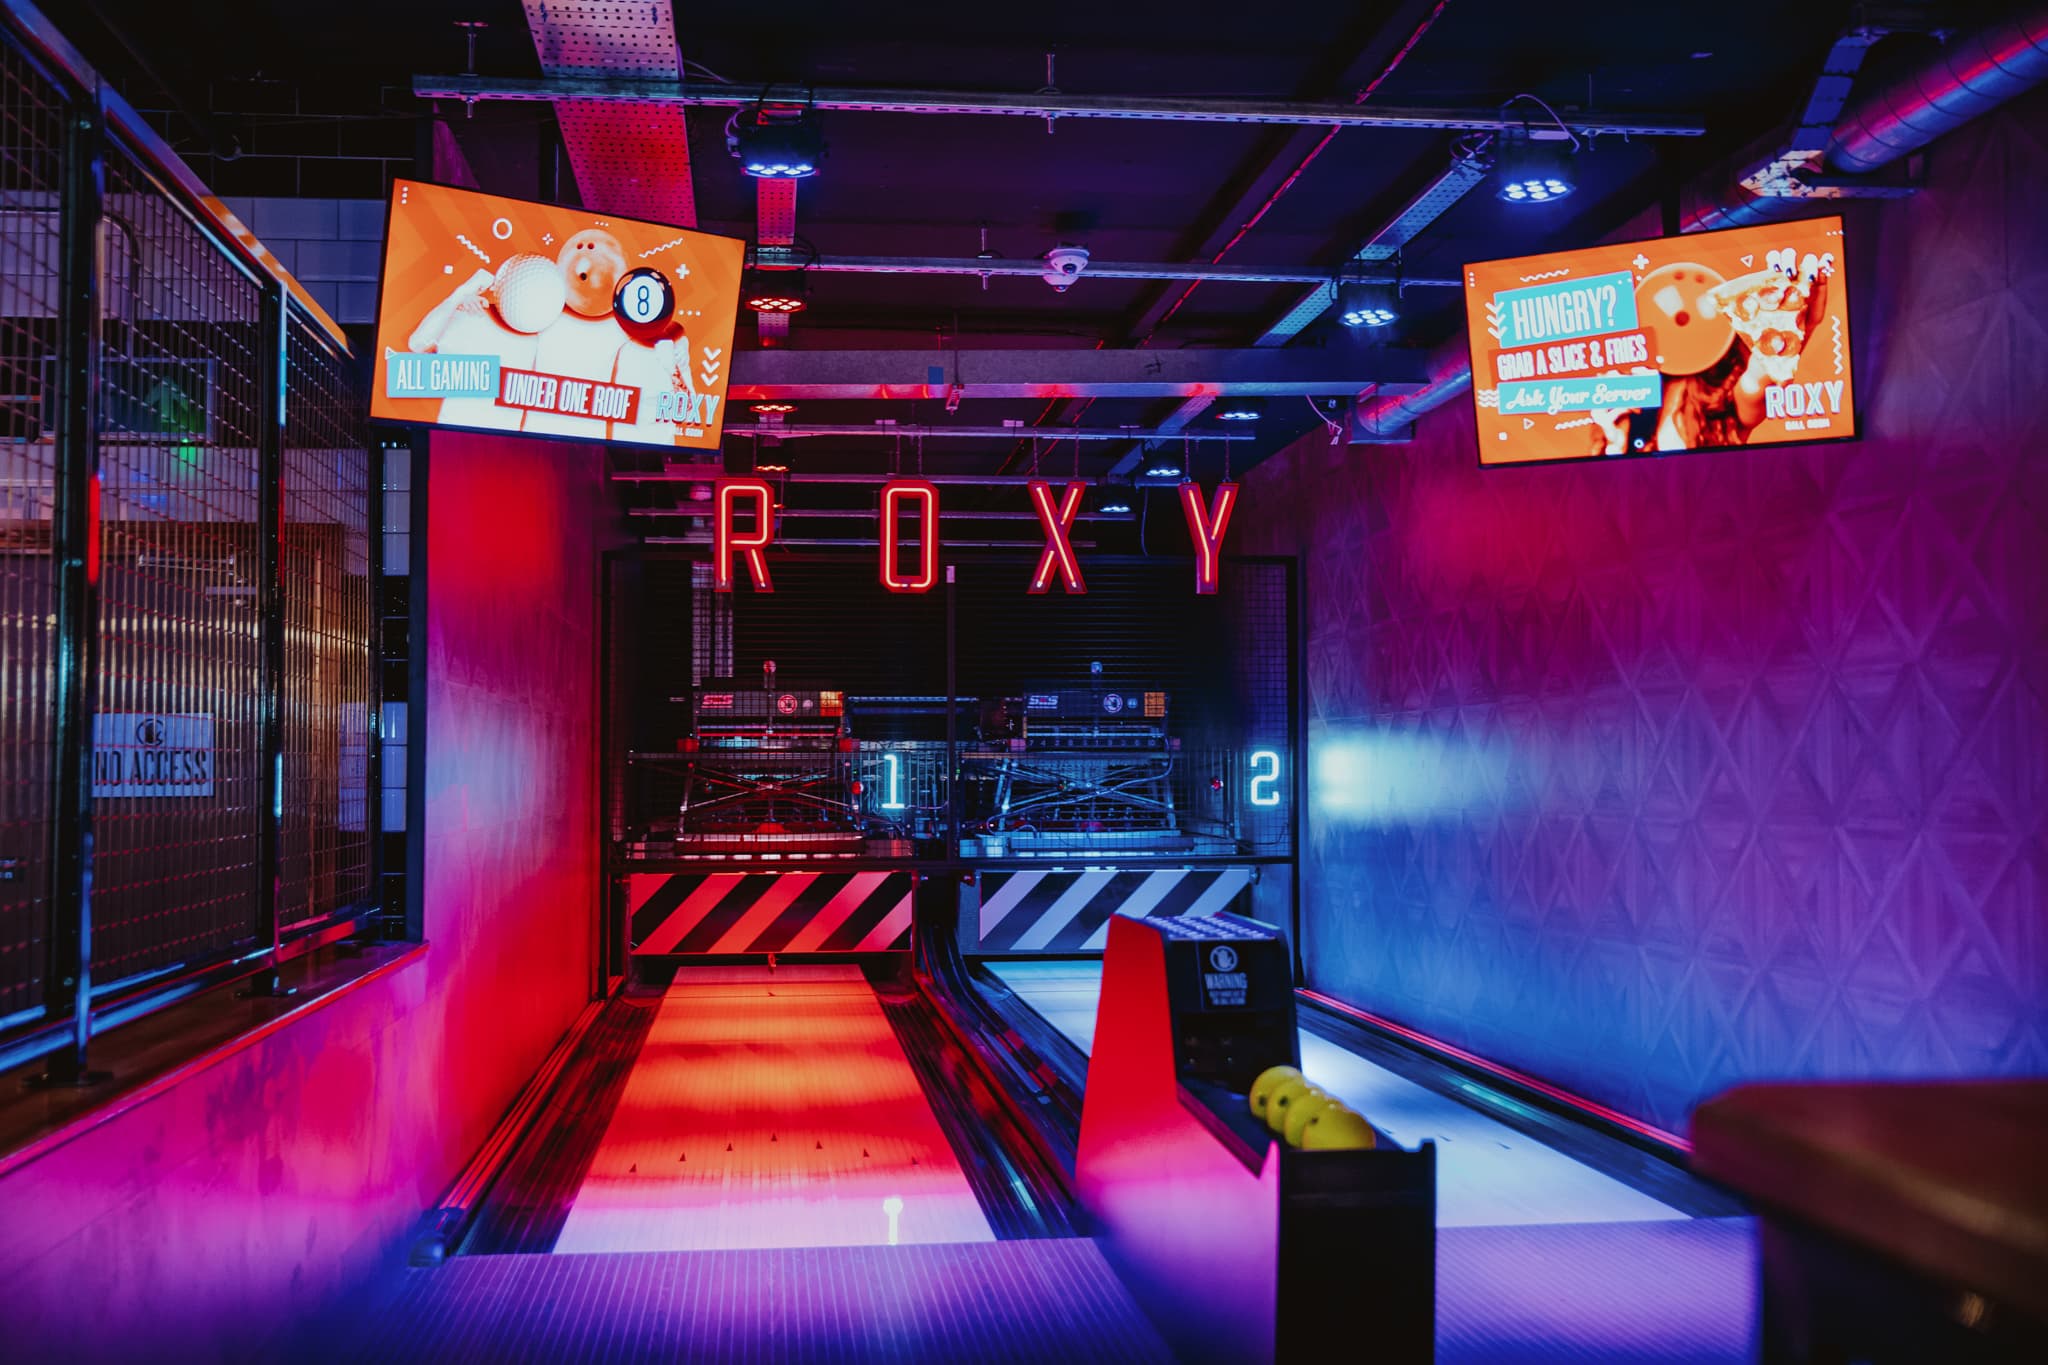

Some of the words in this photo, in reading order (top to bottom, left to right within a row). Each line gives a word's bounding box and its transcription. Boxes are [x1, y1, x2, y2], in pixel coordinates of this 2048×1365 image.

[637, 285, 650, 316] 8
[1511, 284, 1617, 341] HUNGRY?
[396, 359, 425, 391] ALL
[430, 359, 490, 392] GAMING
[1497, 351, 1535, 381] GRAB
[1536, 349, 1548, 375] A
[1548, 343, 1589, 374] SLICE
[1589, 340, 1604, 367] &
[1605, 334, 1648, 365] FRIES
[504, 371, 557, 410] UNDER
[558, 380, 591, 415] ONE
[592, 385, 634, 420] ROOF
[656, 391, 720, 427] ROXY
[1505, 387, 1546, 410] Ask
[1547, 386, 1590, 415] Your
[1592, 383, 1652, 404] Server
[1764, 380, 1844, 420] ROXY
[714, 478, 1240, 594] ROXY
[95, 751, 121, 786] NO
[129, 751, 207, 786] ACCESS
[881, 754, 905, 809] 1
[1249, 751, 1281, 806] 2
[1204, 972, 1249, 989] WARNING
